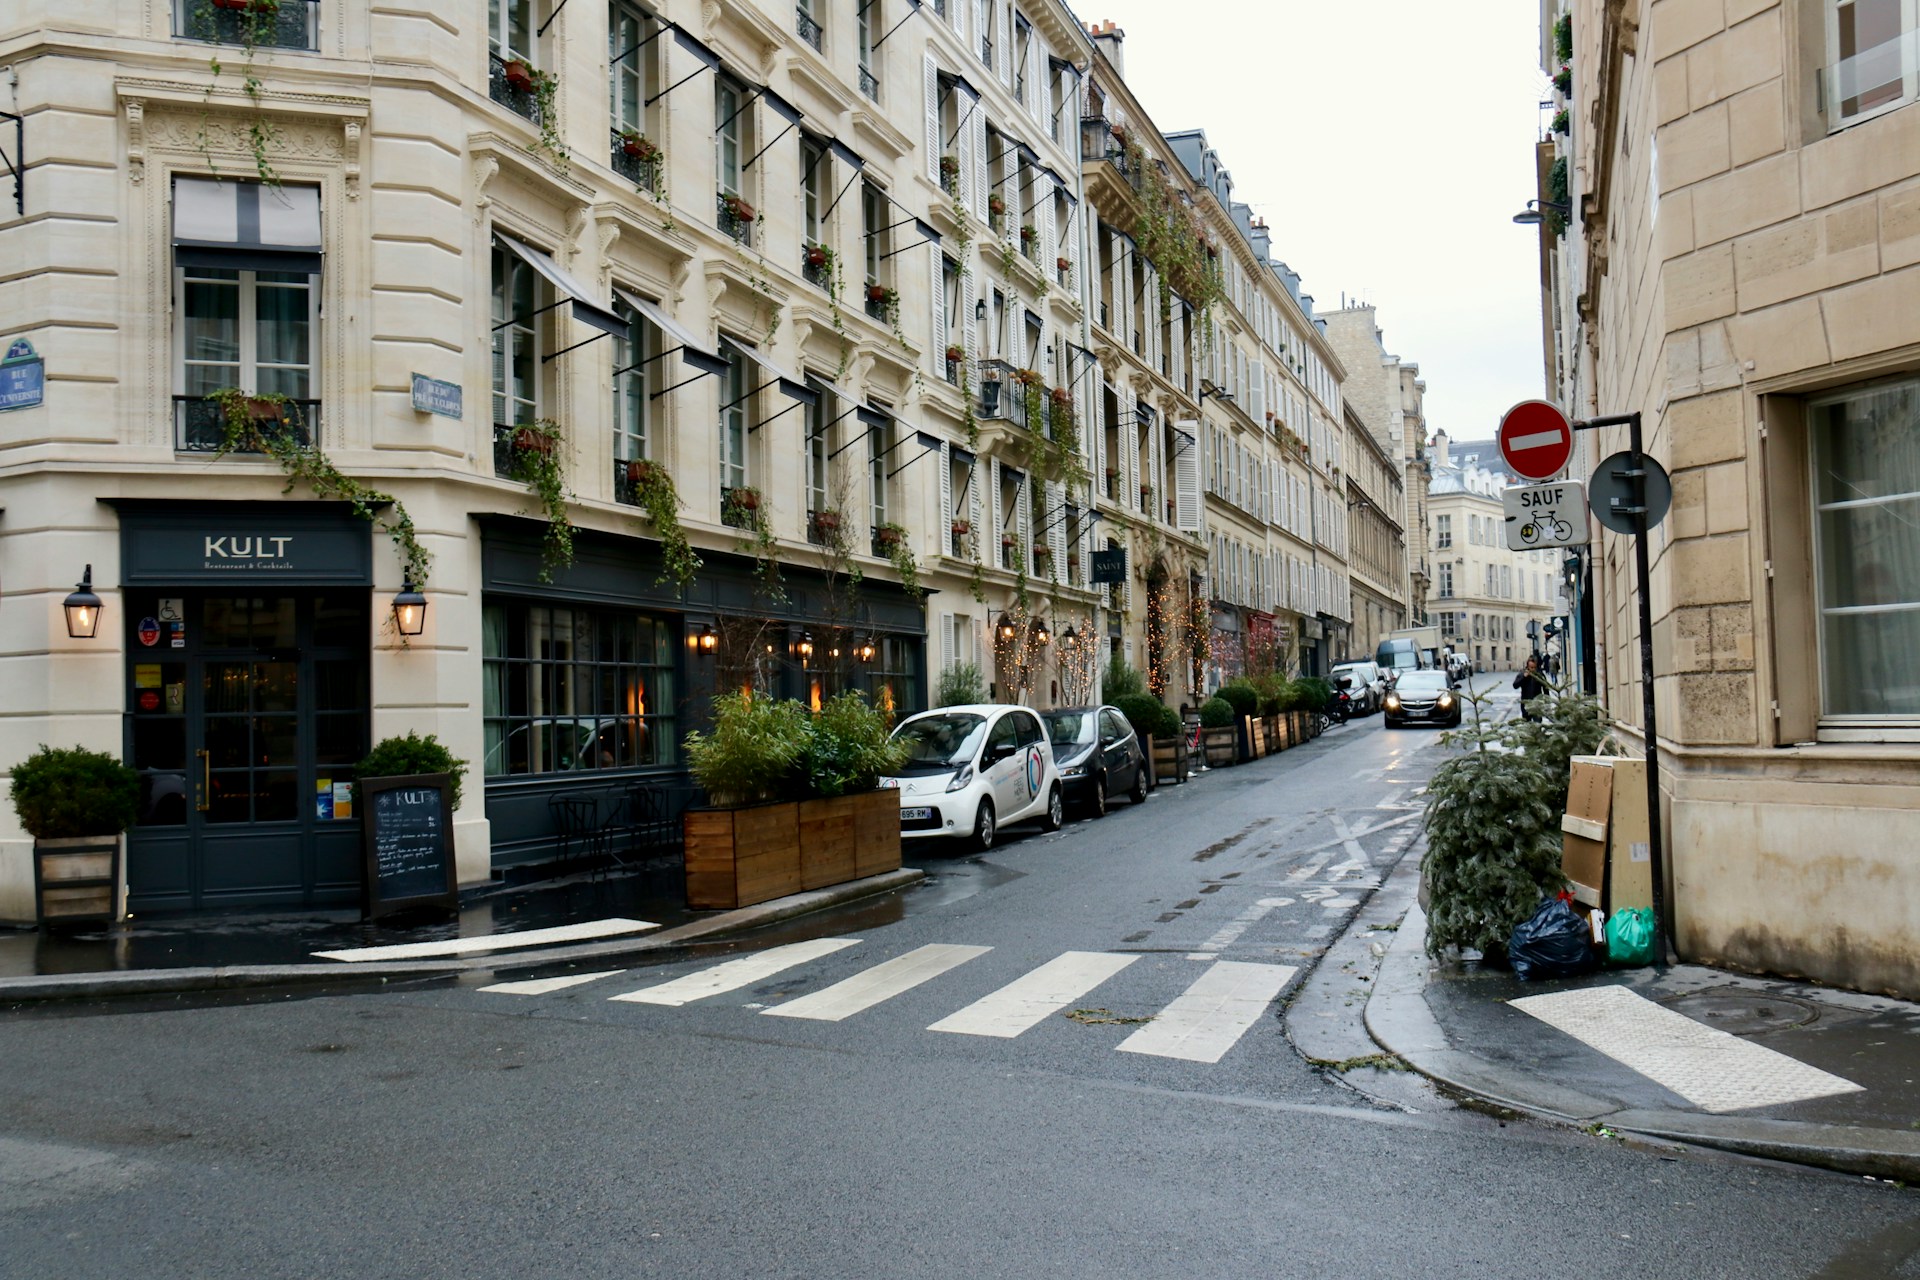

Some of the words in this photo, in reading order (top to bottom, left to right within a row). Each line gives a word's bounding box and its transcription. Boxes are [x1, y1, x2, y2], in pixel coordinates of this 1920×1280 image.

[11, 369, 27, 379] RUE
[14, 381, 25, 390] DE
[1521, 488, 1563, 507] SAUF
[205, 536, 293, 558] KULT
[1096, 562, 1121, 571] SAINT
[396, 790, 431, 806] KULT
